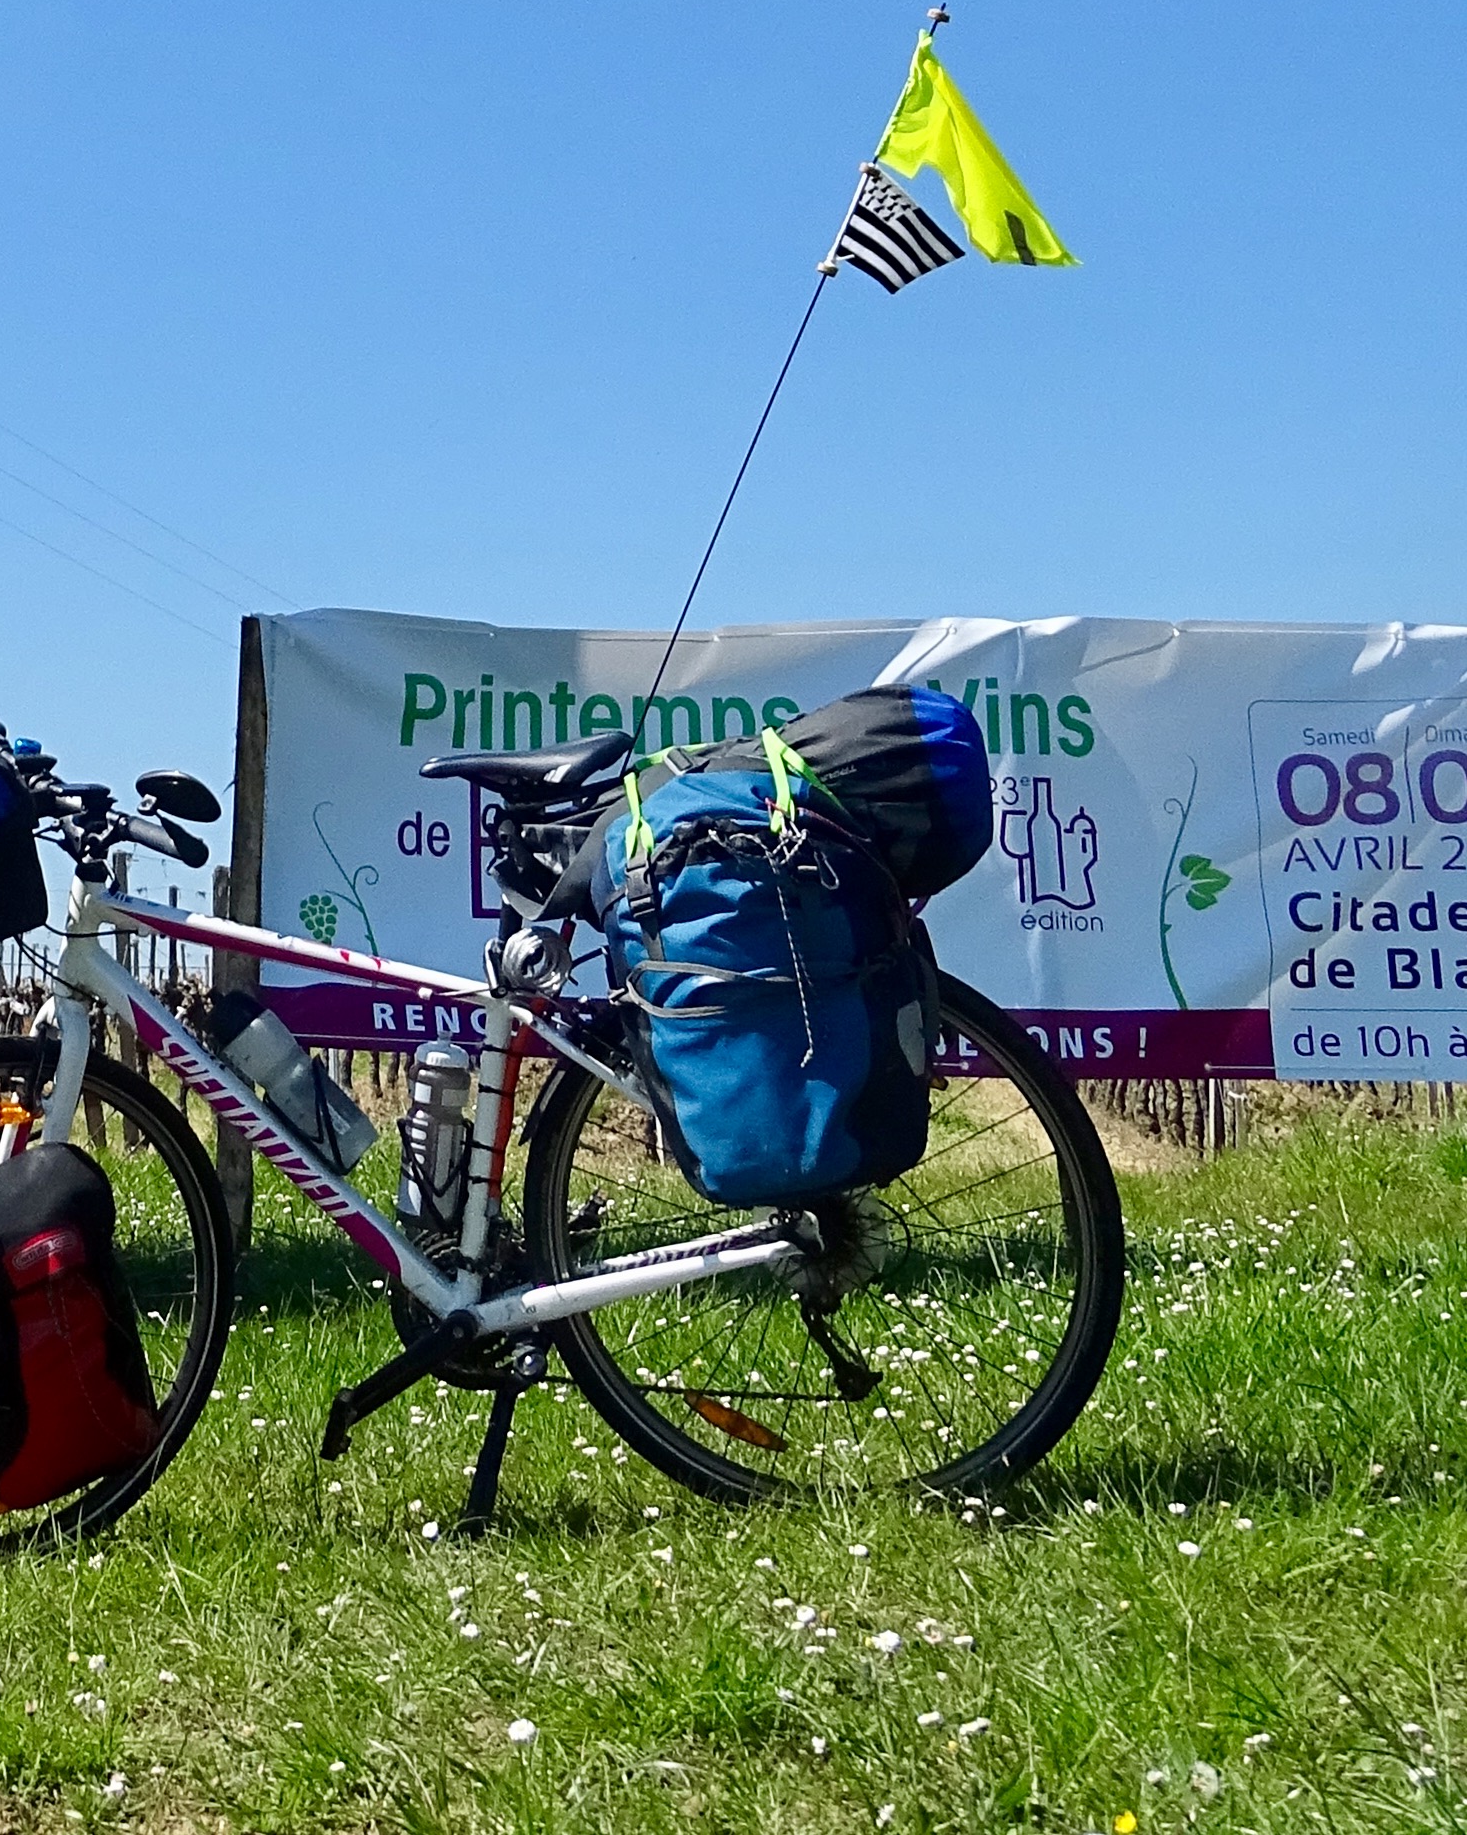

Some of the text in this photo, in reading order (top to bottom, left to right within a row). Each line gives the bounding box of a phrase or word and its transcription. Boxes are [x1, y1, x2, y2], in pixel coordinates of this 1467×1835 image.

[1302, 727, 1376, 746] Samedi
[1276, 751, 1401, 826] 08
[397, 810, 451, 857] de
[1283, 835, 1424, 872] AVRIL
[1020, 909, 1105, 933] édition
[1289, 947, 1356, 989] de
[1292, 1024, 1342, 1057] de
[1356, 1025, 1431, 1058] 10h
[155, 1035, 362, 1219] SPECIALIZED
